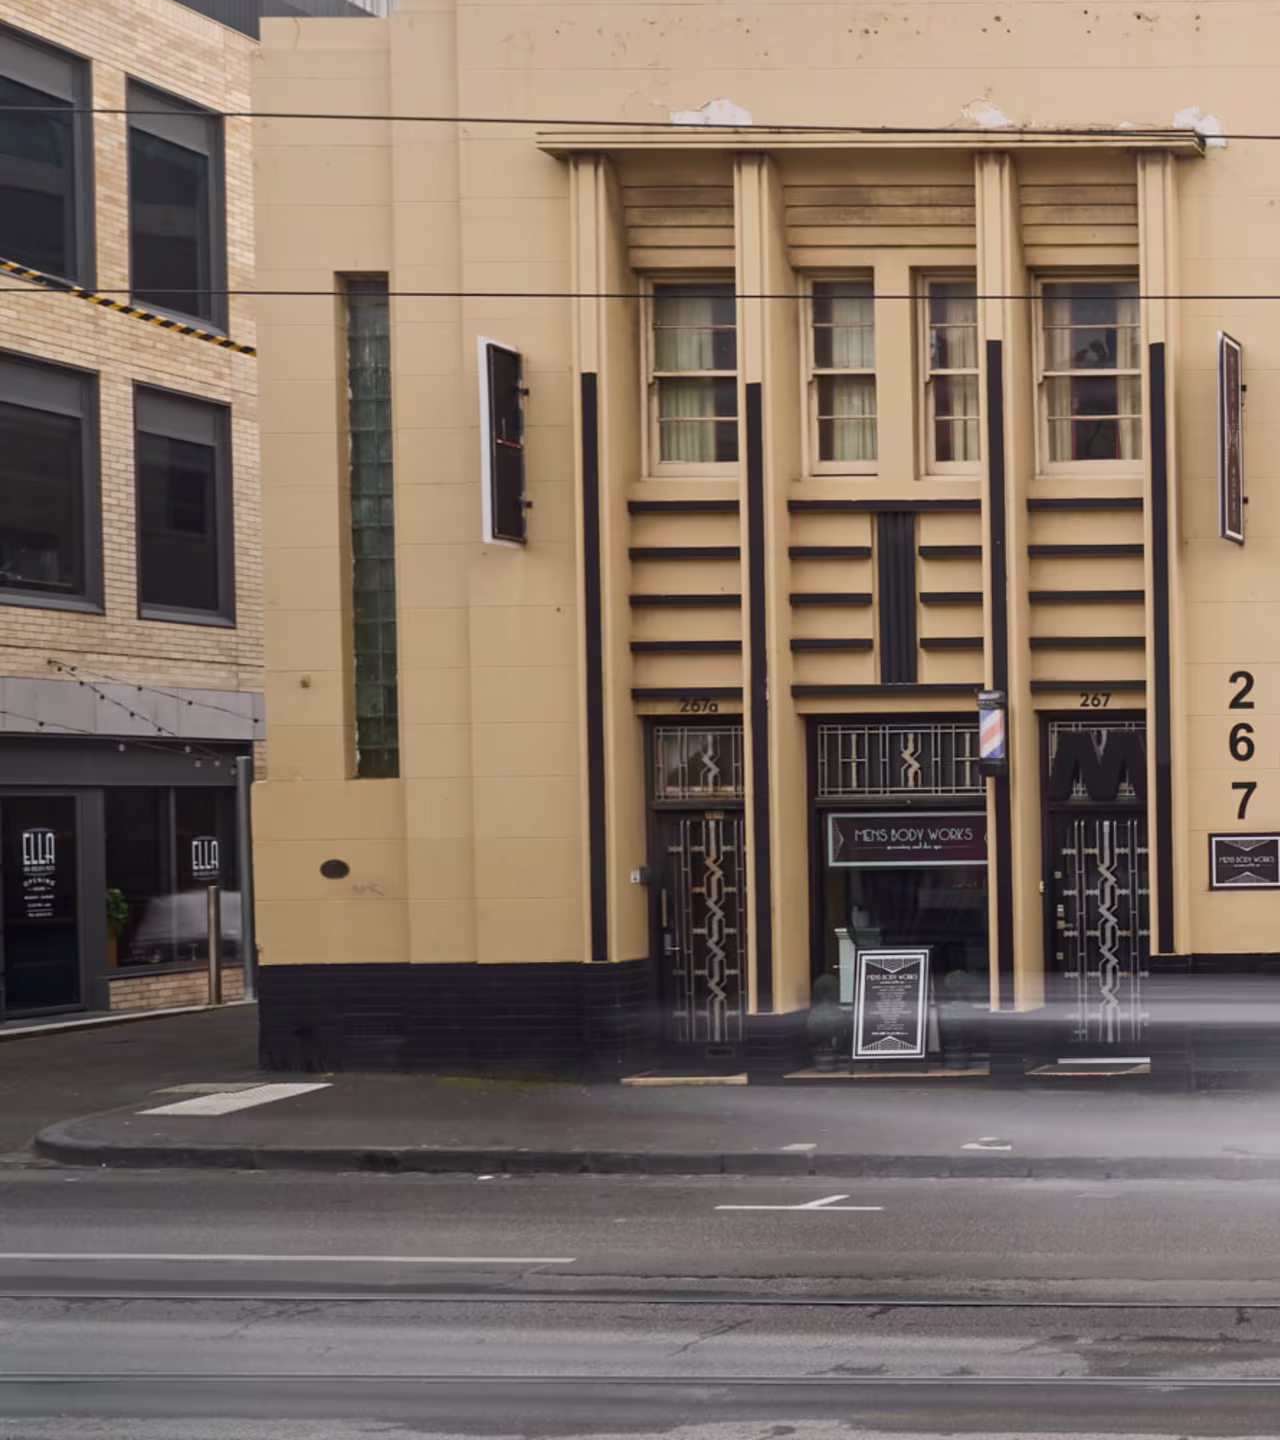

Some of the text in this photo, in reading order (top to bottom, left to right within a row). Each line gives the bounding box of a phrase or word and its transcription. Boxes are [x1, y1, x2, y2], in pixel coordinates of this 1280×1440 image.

[680, 698, 718, 713] 267a
[1080, 692, 1112, 708] 267
[1229, 670, 1257, 820] 267
[855, 828, 973, 841] MENS BODY WORKS
[23, 832, 55, 865] ELLA
[192, 841, 219, 870] ELLA
